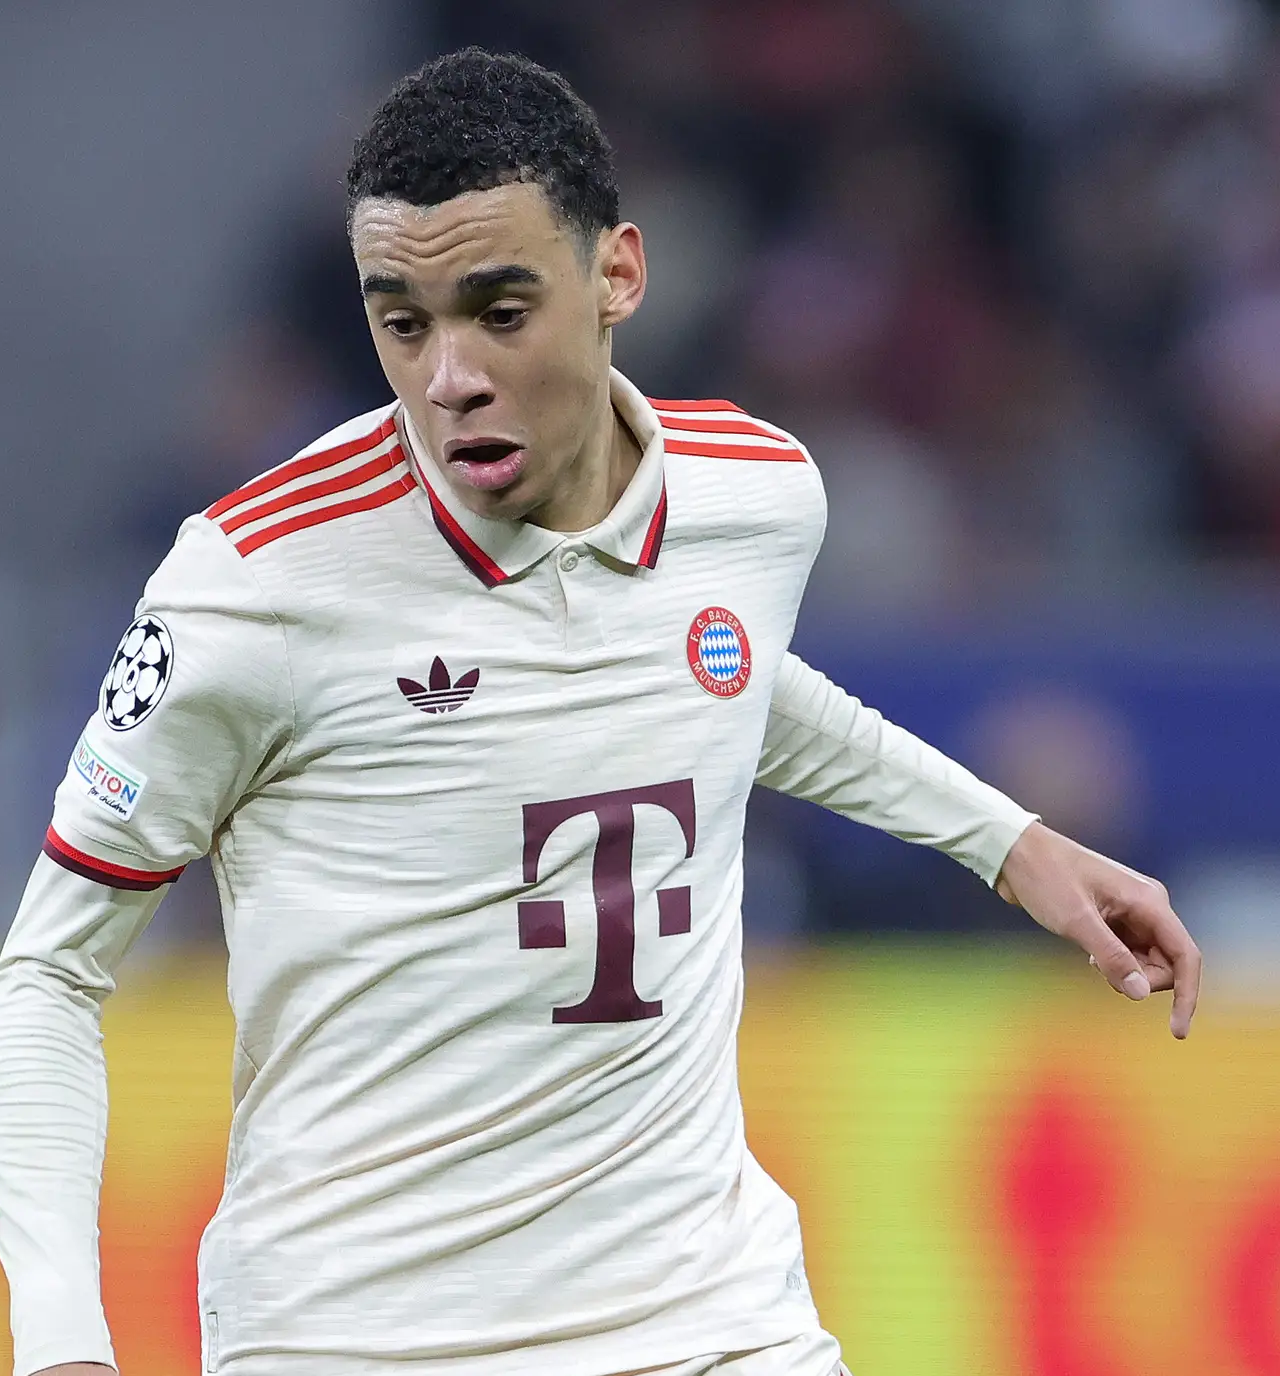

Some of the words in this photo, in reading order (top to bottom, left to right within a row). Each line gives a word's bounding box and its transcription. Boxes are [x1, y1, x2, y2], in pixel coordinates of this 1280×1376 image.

[708, 610, 745, 638] BAYERN
[121, 650, 146, 694] 6
[99, 794, 128, 816] children
[517, 778, 696, 1024] T
